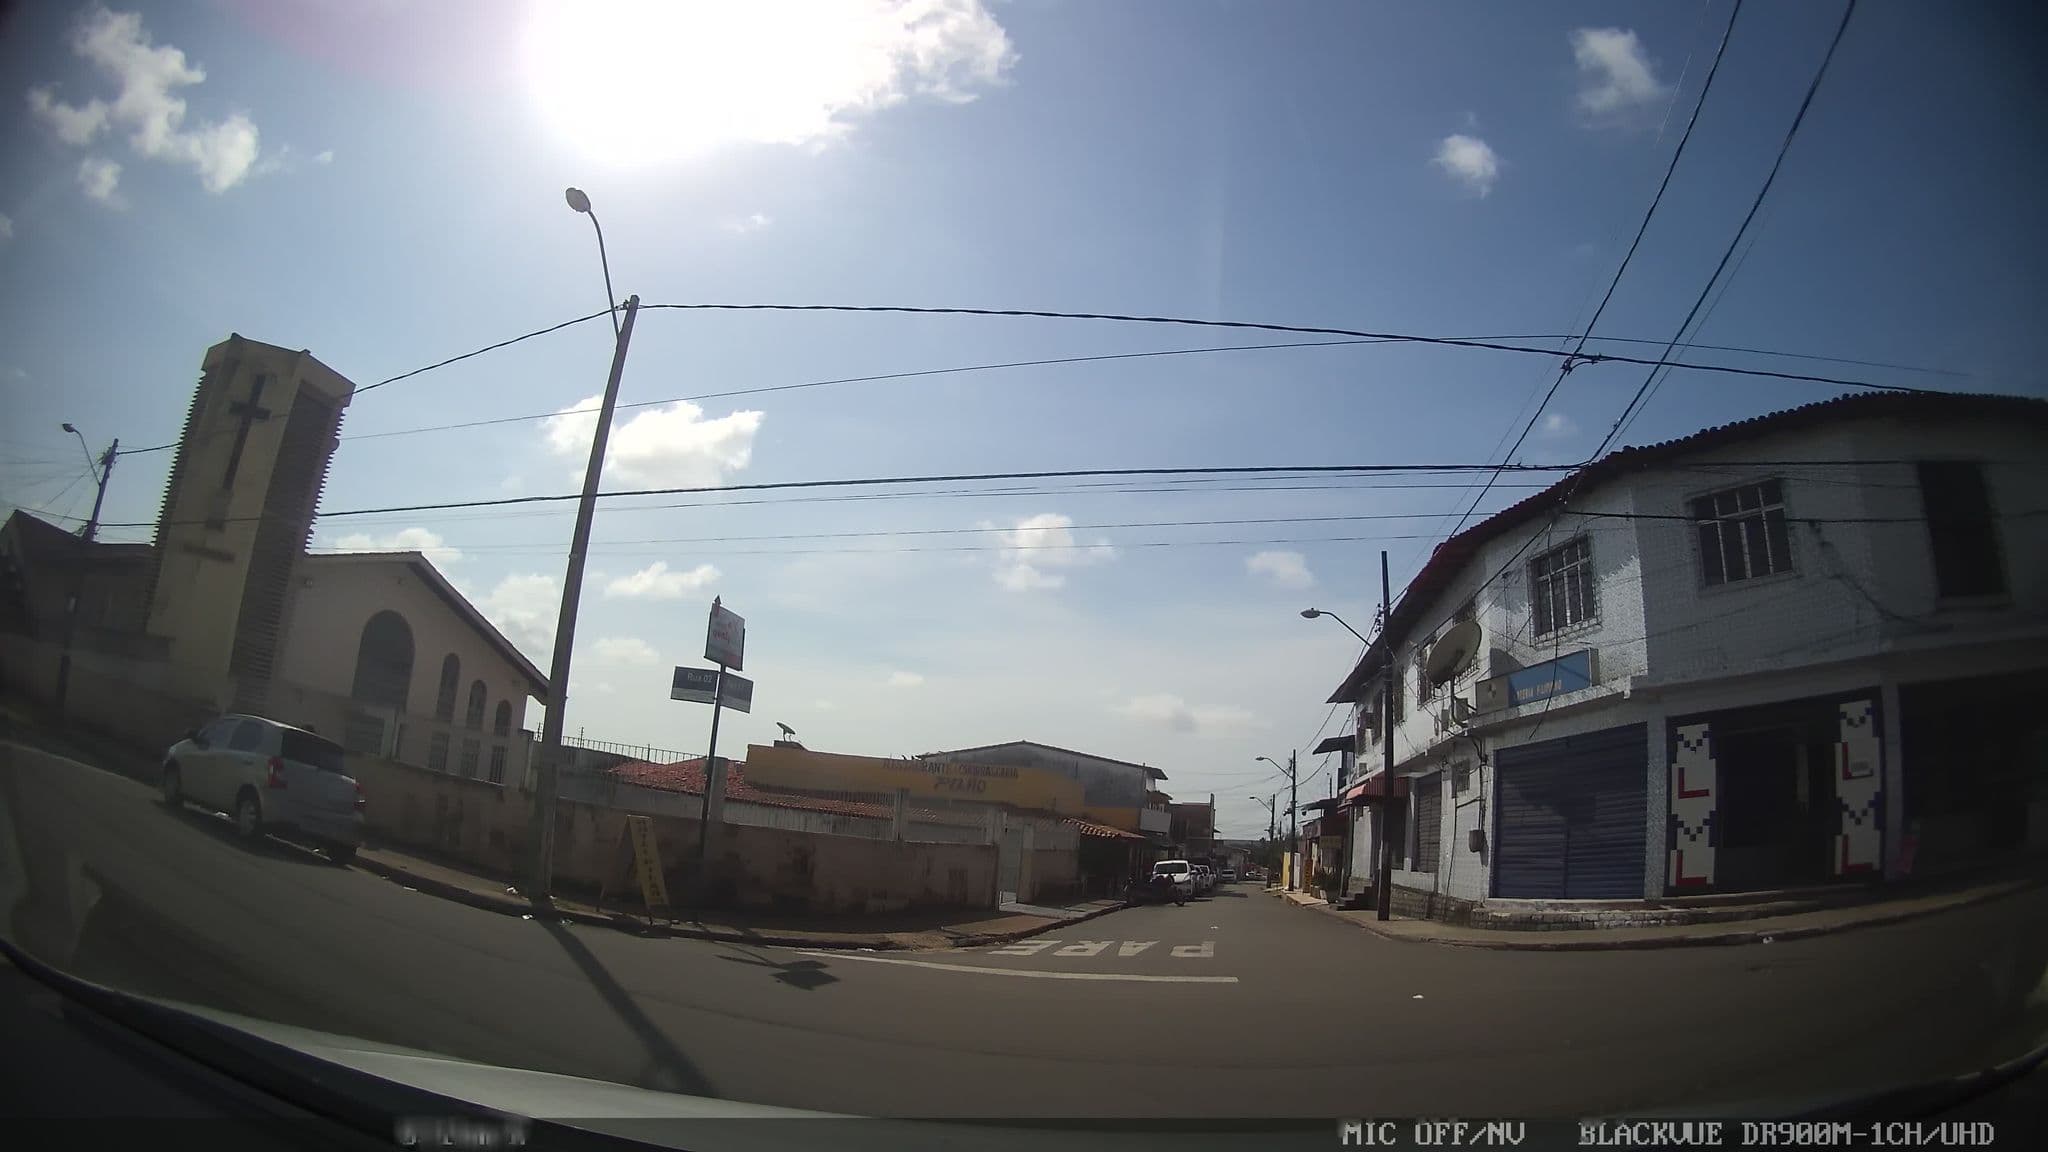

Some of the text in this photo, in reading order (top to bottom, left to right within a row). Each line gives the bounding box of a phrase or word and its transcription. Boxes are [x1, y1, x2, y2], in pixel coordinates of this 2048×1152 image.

[687, 672, 713, 683] Rua 02
[987, 940, 1216, 958] PARE
